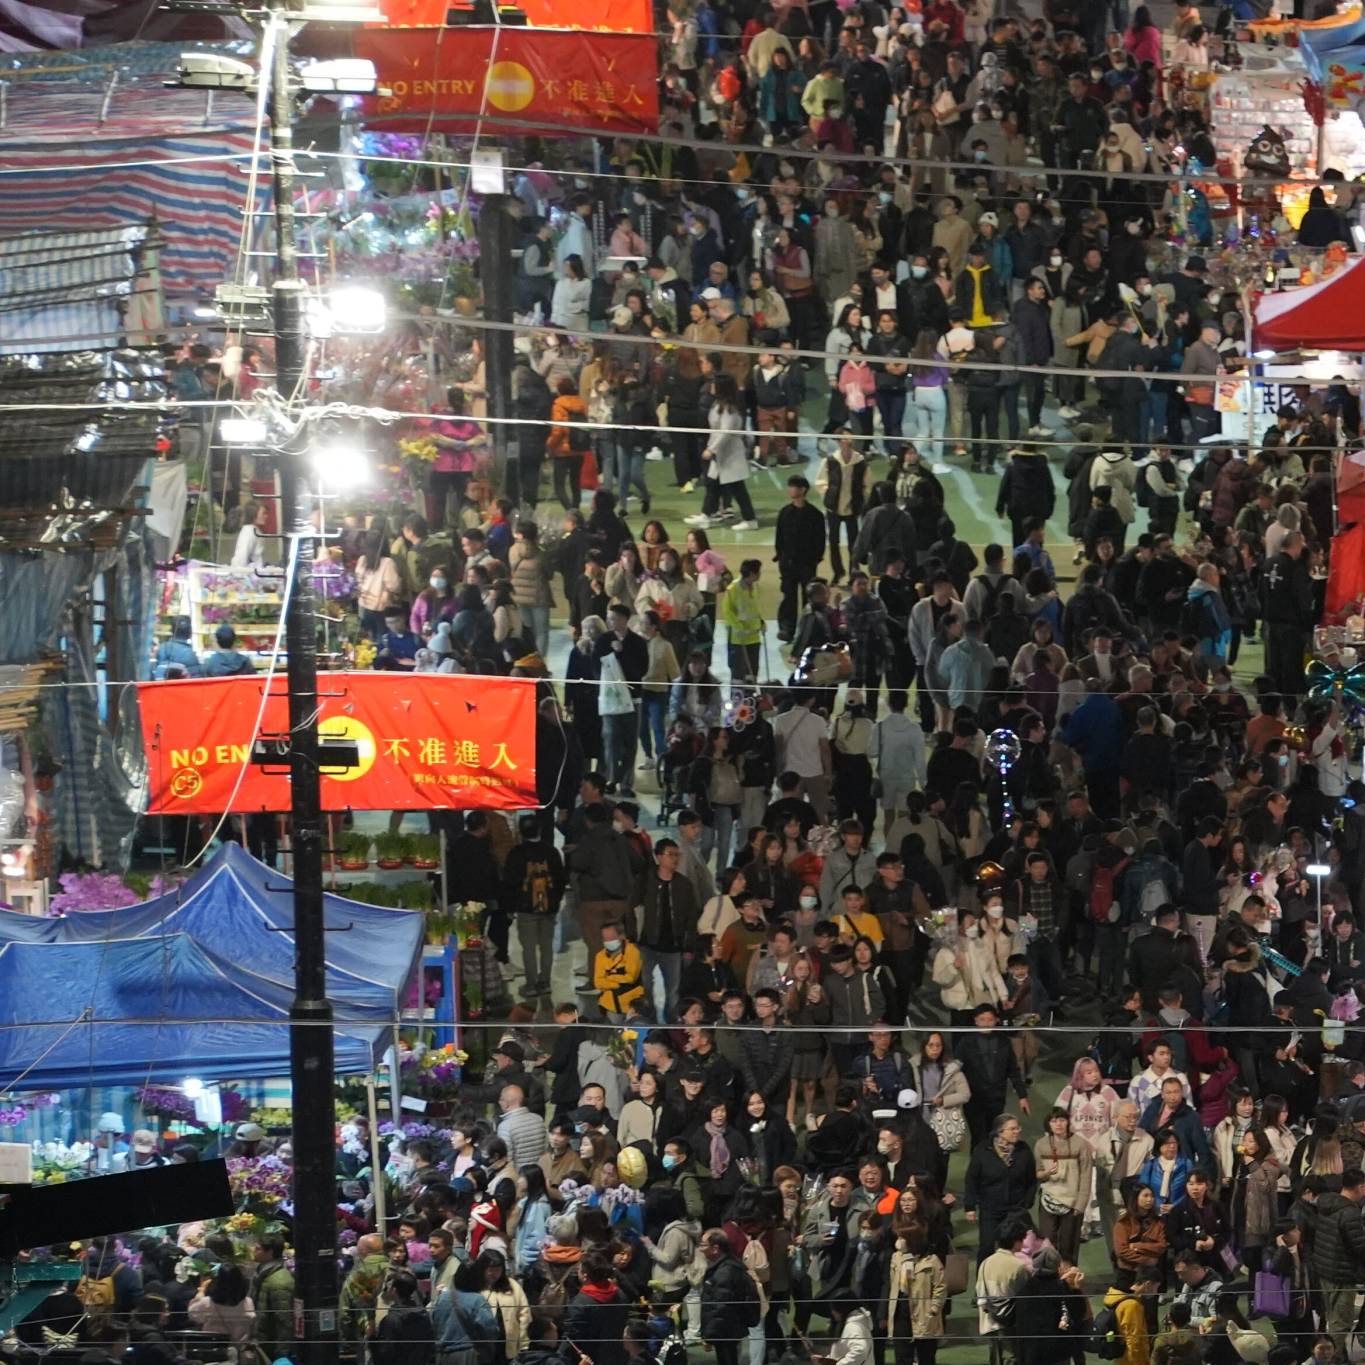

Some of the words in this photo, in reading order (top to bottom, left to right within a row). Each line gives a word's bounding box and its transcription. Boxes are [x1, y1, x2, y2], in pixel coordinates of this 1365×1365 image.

[413, 79, 475, 96] ENTRY
[170, 746, 209, 768] NO
[383, 736, 519, 770] 不准進入
[174, 777, 199, 791] C5
